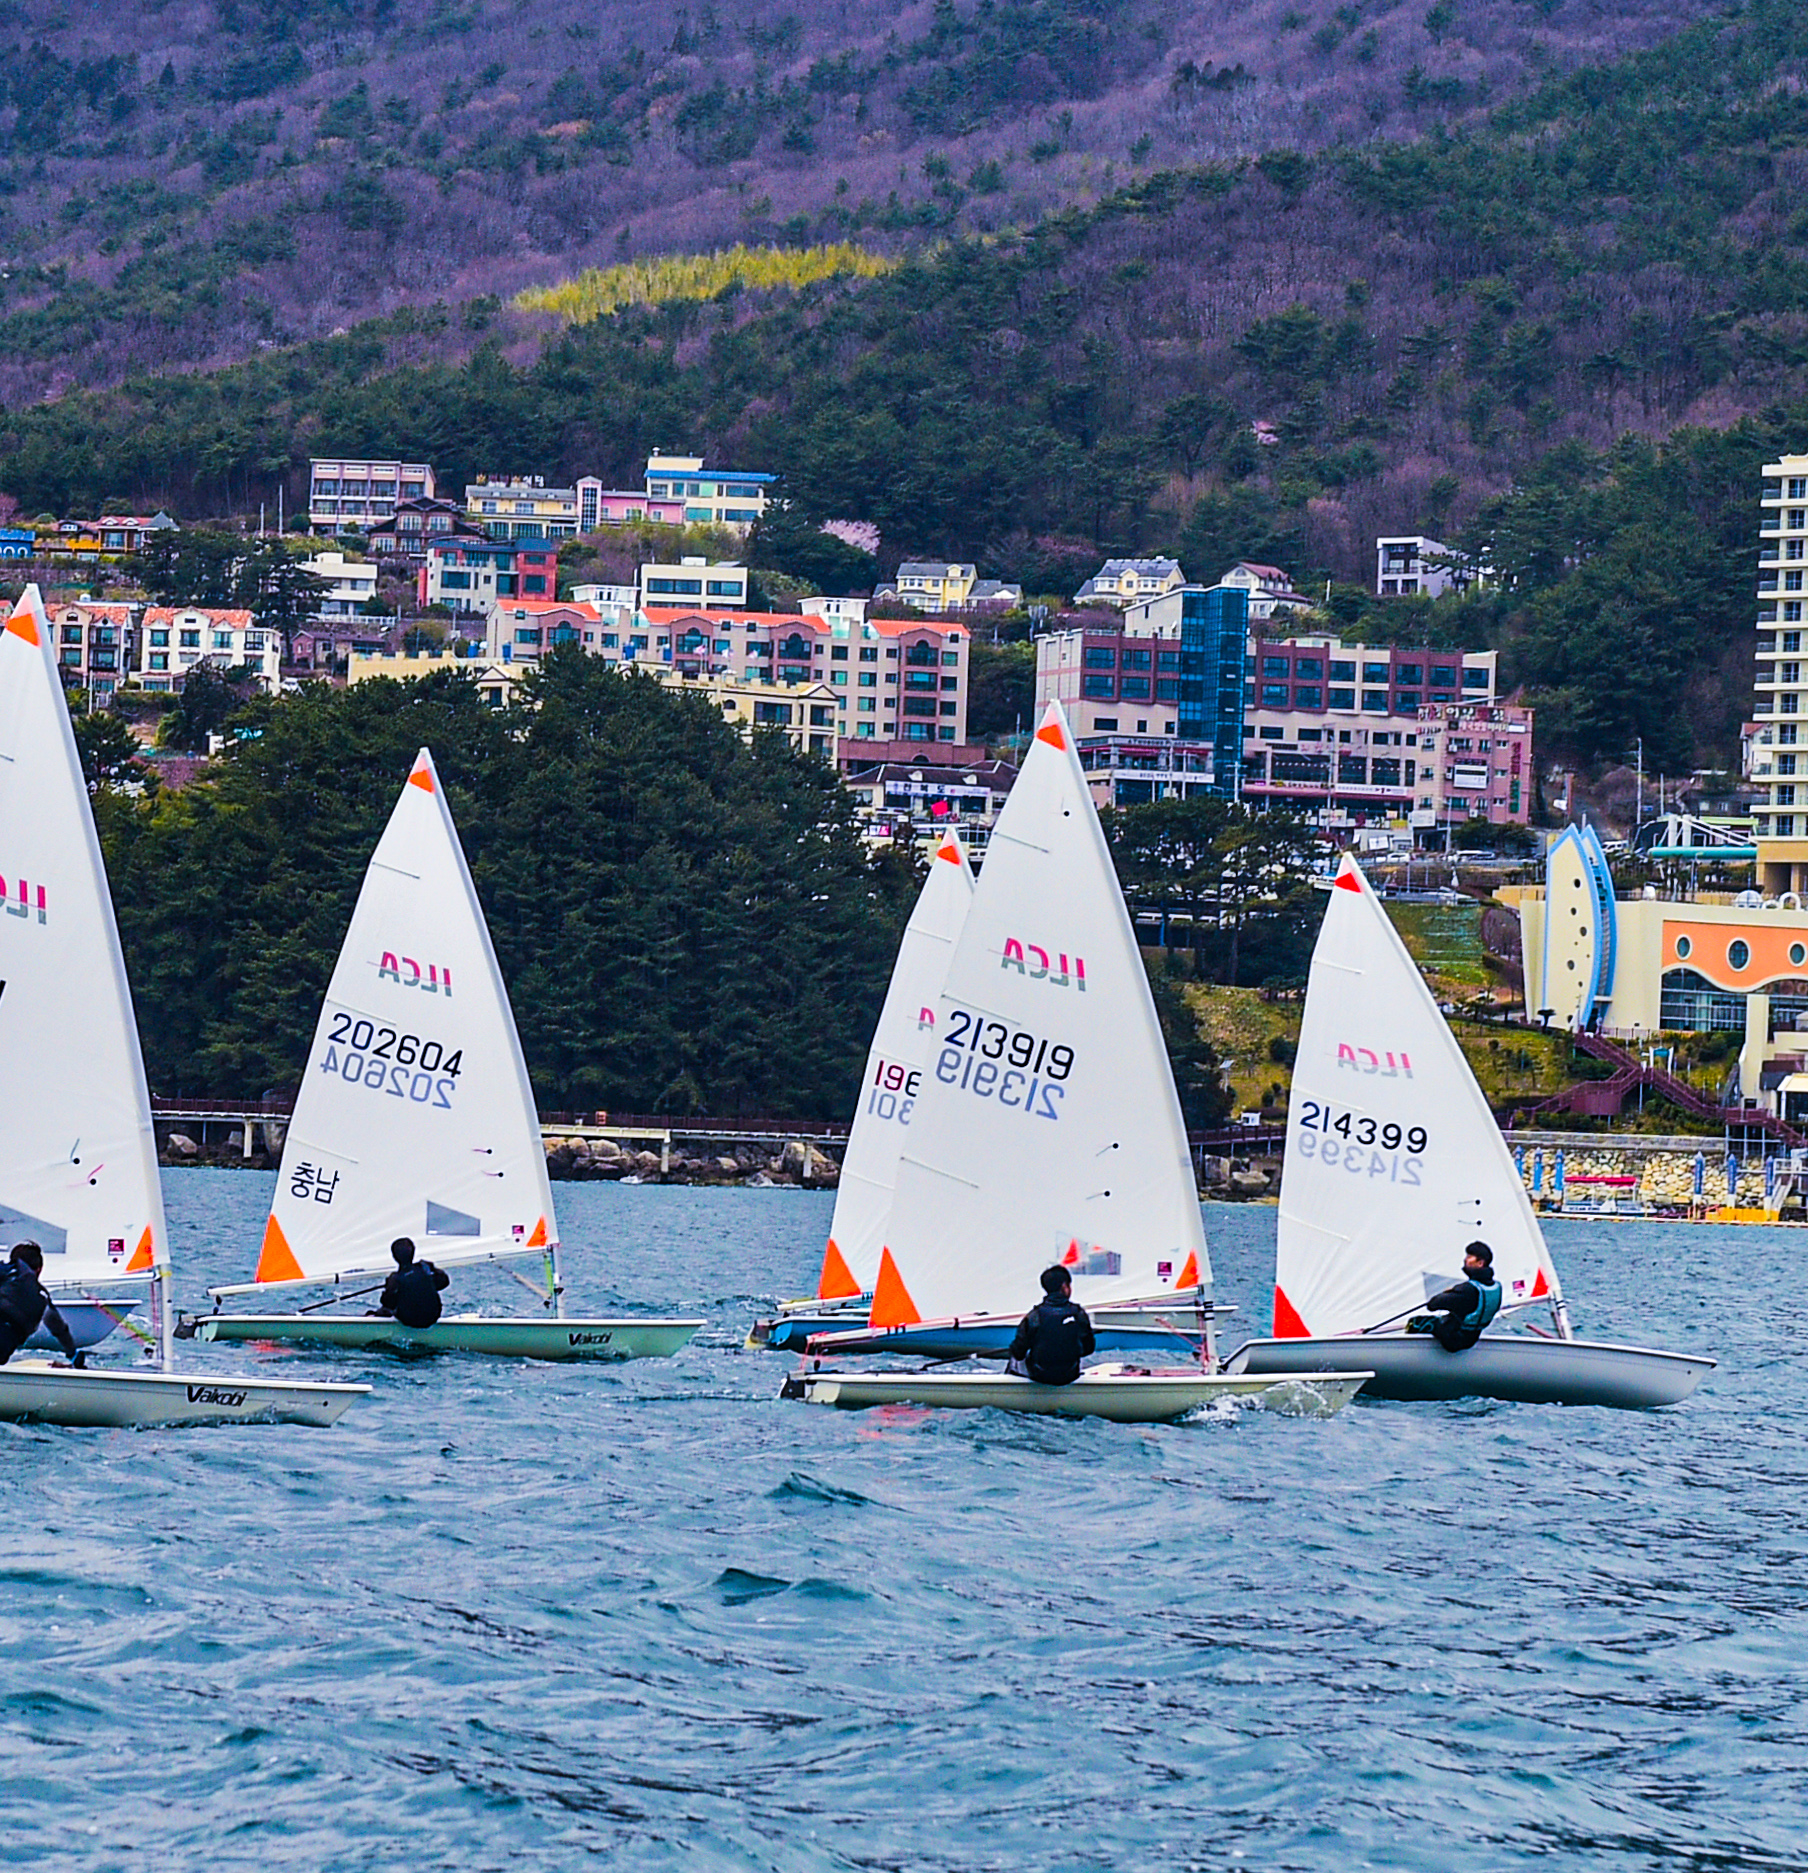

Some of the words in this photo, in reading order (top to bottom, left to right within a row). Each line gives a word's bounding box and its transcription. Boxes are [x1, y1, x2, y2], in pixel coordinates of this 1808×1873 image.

[328, 1012, 463, 1078] 202604
[944, 1010, 1074, 1081] 213919
[1300, 1100, 1427, 1155] 214399
[290, 1160, 340, 1205] 충남
[568, 1330, 613, 1347] Vaikobi
[186, 1385, 248, 1407] Vaikobi
